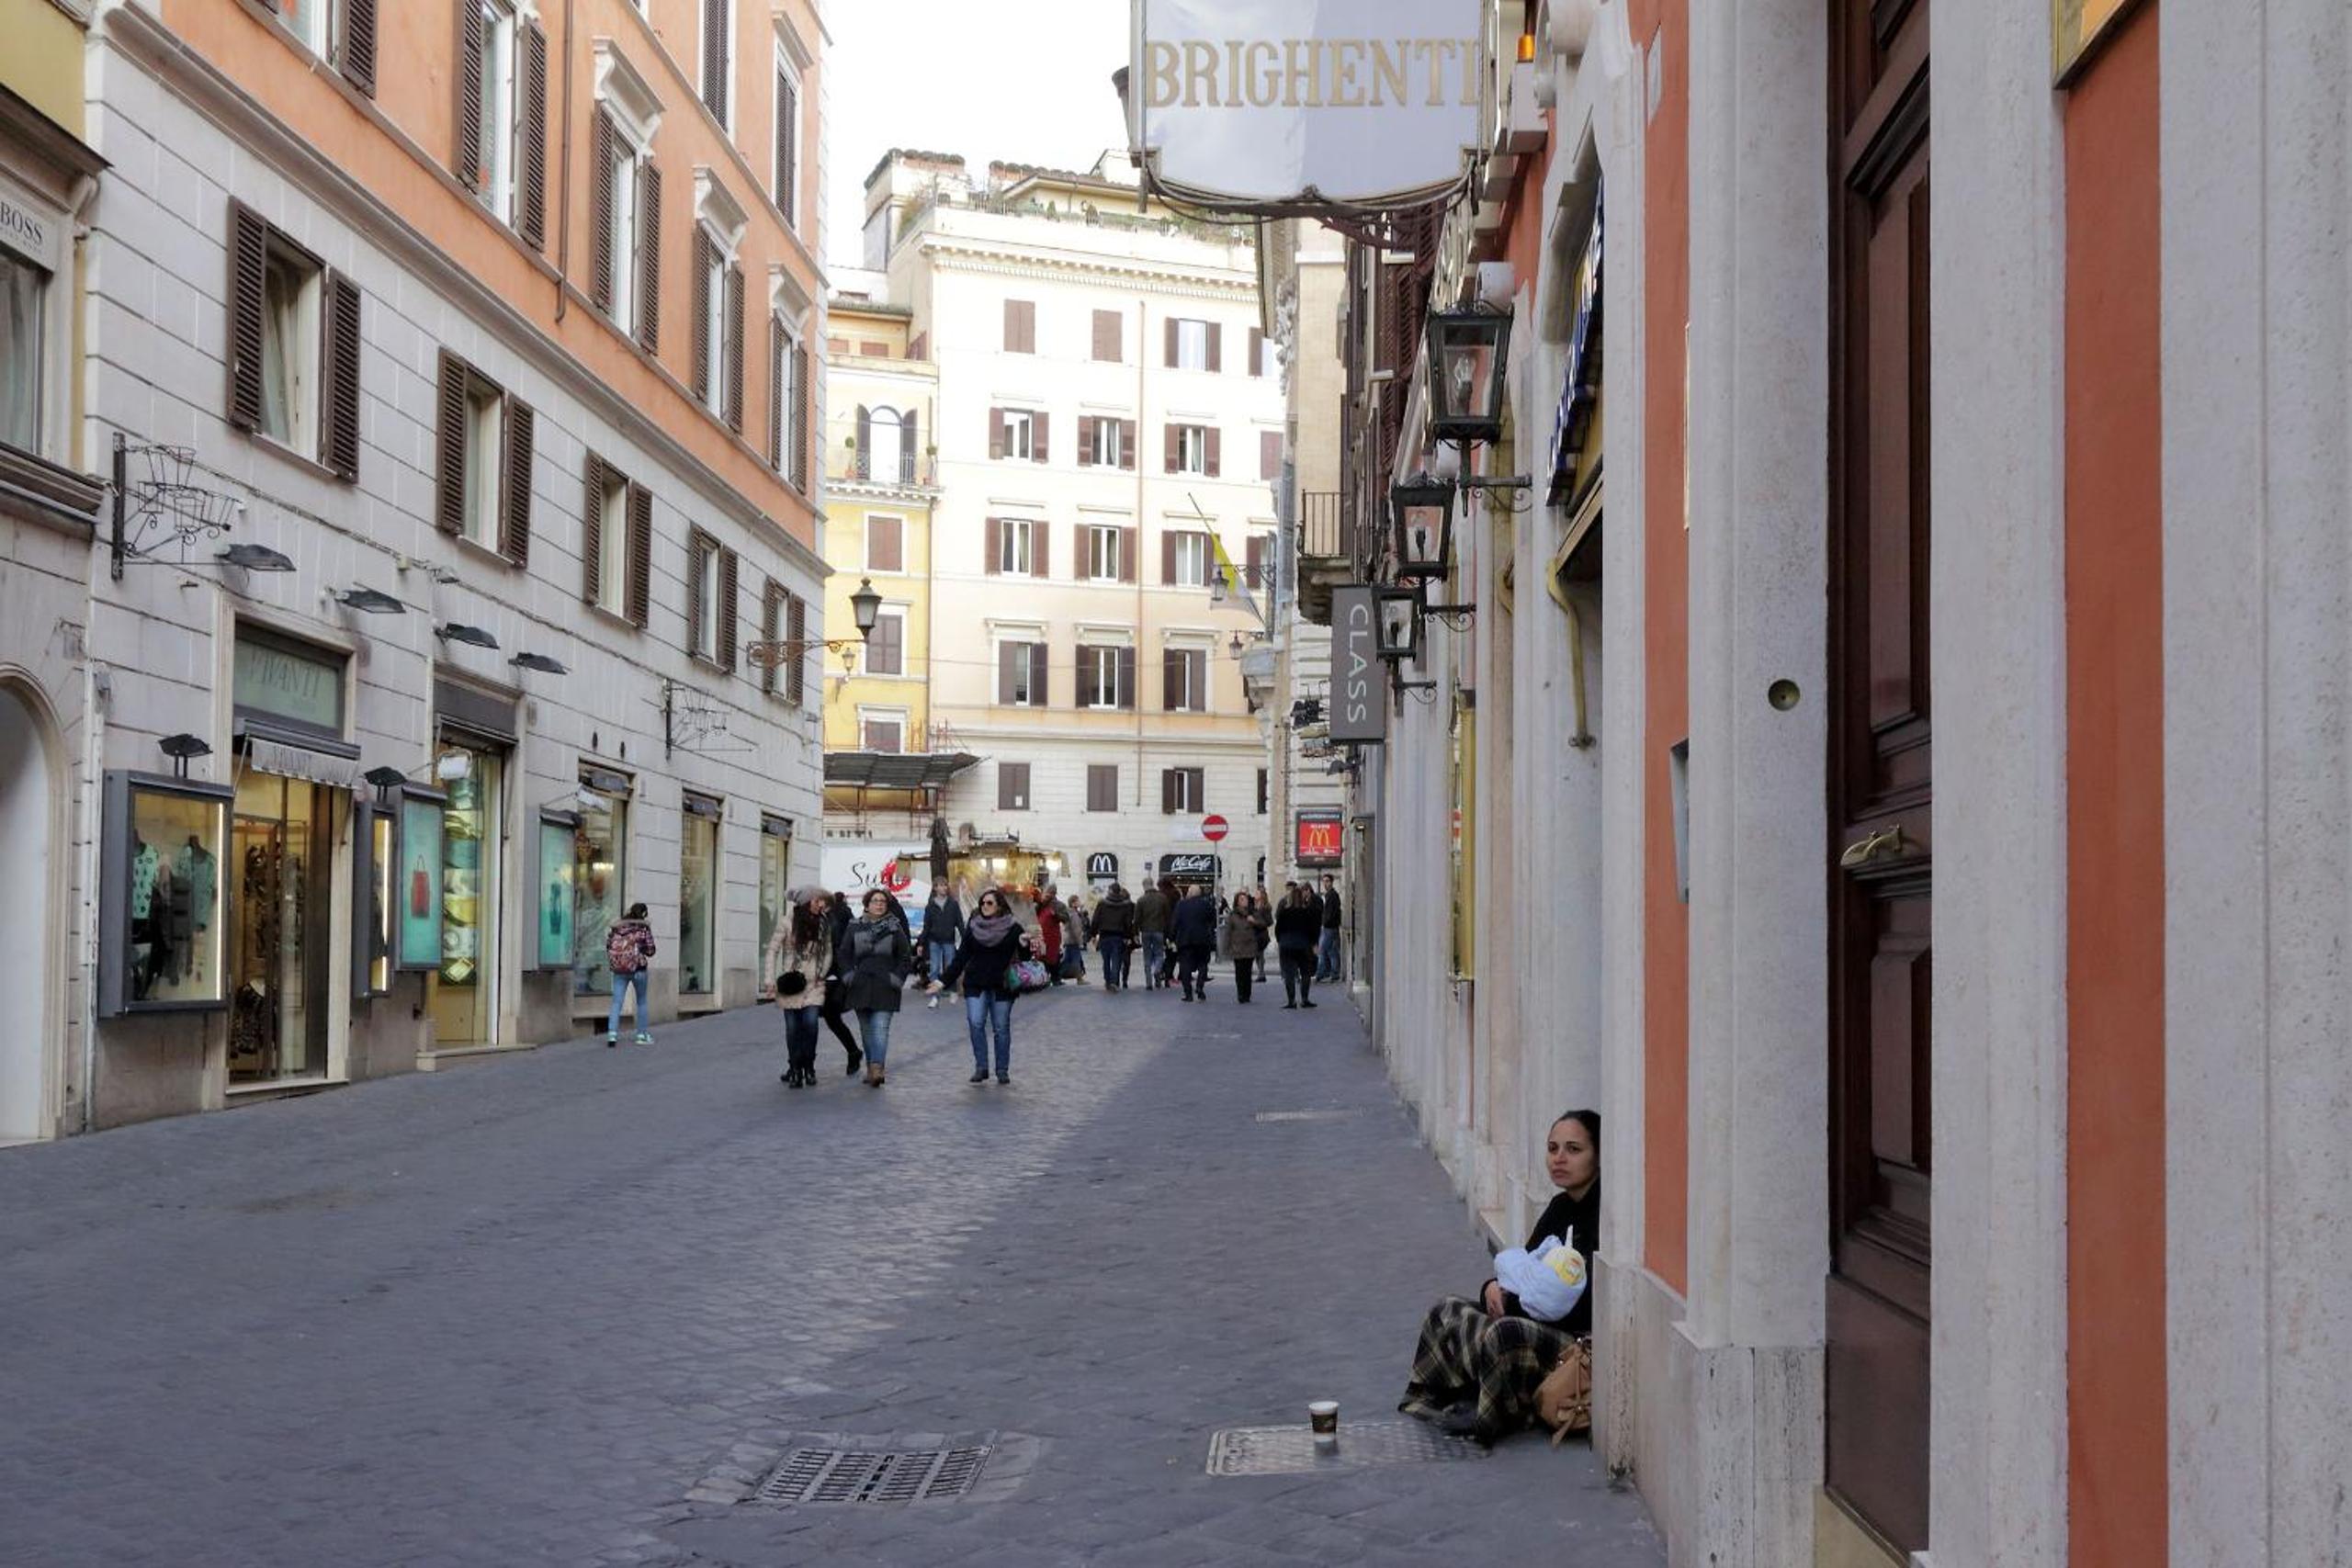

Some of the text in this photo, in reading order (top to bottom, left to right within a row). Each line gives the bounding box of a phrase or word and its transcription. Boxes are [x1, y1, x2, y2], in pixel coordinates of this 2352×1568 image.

[1146, 39, 1479, 107] BRIGHENTI
[0, 201, 44, 246] BOSS
[1347, 604, 1368, 723] CLASS
